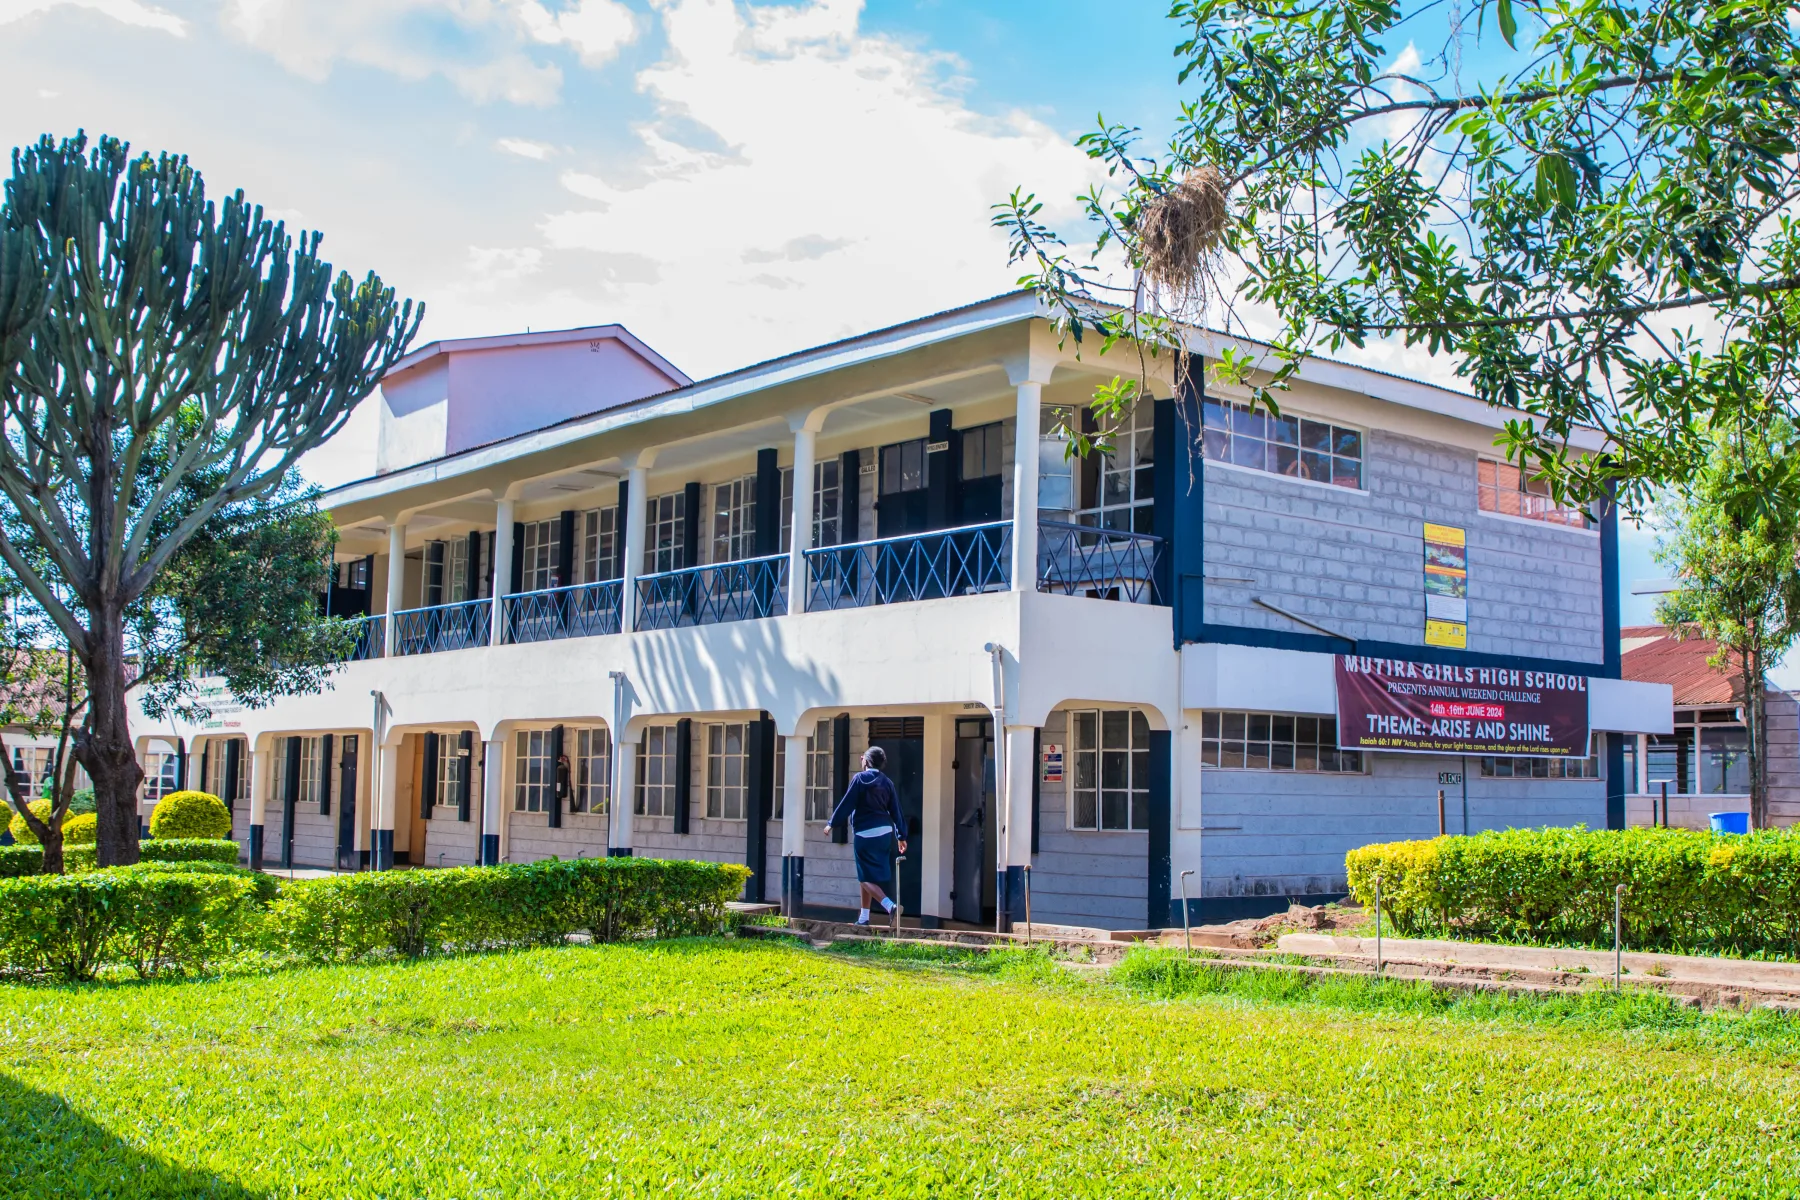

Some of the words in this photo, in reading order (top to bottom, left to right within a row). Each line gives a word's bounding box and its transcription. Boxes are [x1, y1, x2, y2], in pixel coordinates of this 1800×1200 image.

[1345, 654, 1417, 678] MUTIRA
[1422, 663, 1474, 683] GIRLS
[1480, 669, 1520, 687] HIGH
[1525, 671, 1586, 692] SCHOOL
[1387, 682, 1427, 695] PRESENTS
[1428, 685, 1460, 698] ANNUAL
[1461, 688, 1498, 701] WEEKEND
[1499, 690, 1541, 703] CHALLENGE
[1430, 703, 1445, 714] 14th
[1465, 706, 1485, 716] JUNE
[1486, 706, 1502, 717] 2024
[1366, 714, 1426, 736] THEME:
[1430, 718, 1471, 739] ARISE
[1475, 721, 1506, 740] AND
[1509, 722, 1553, 742] SHINE.
[1359, 736, 1377, 745] Isaiah
[1378, 737, 1390, 746] 60:1
[1391, 738, 1402, 746] NIV
[1419, 740, 1433, 749] shine,
[1442, 742, 1452, 750] your
[1453, 741, 1464, 751] light
[1465, 742, 1473, 750] has
[1473, 744, 1487, 752] come,
[1487, 743, 1496, 751] and
[1505, 744, 1516, 753] glory
[1517, 744, 1522, 752] of
[1530, 744, 1539, 753] Lord
[1540, 745, 1549, 753] rises
[1550, 746, 1560, 754] upon
